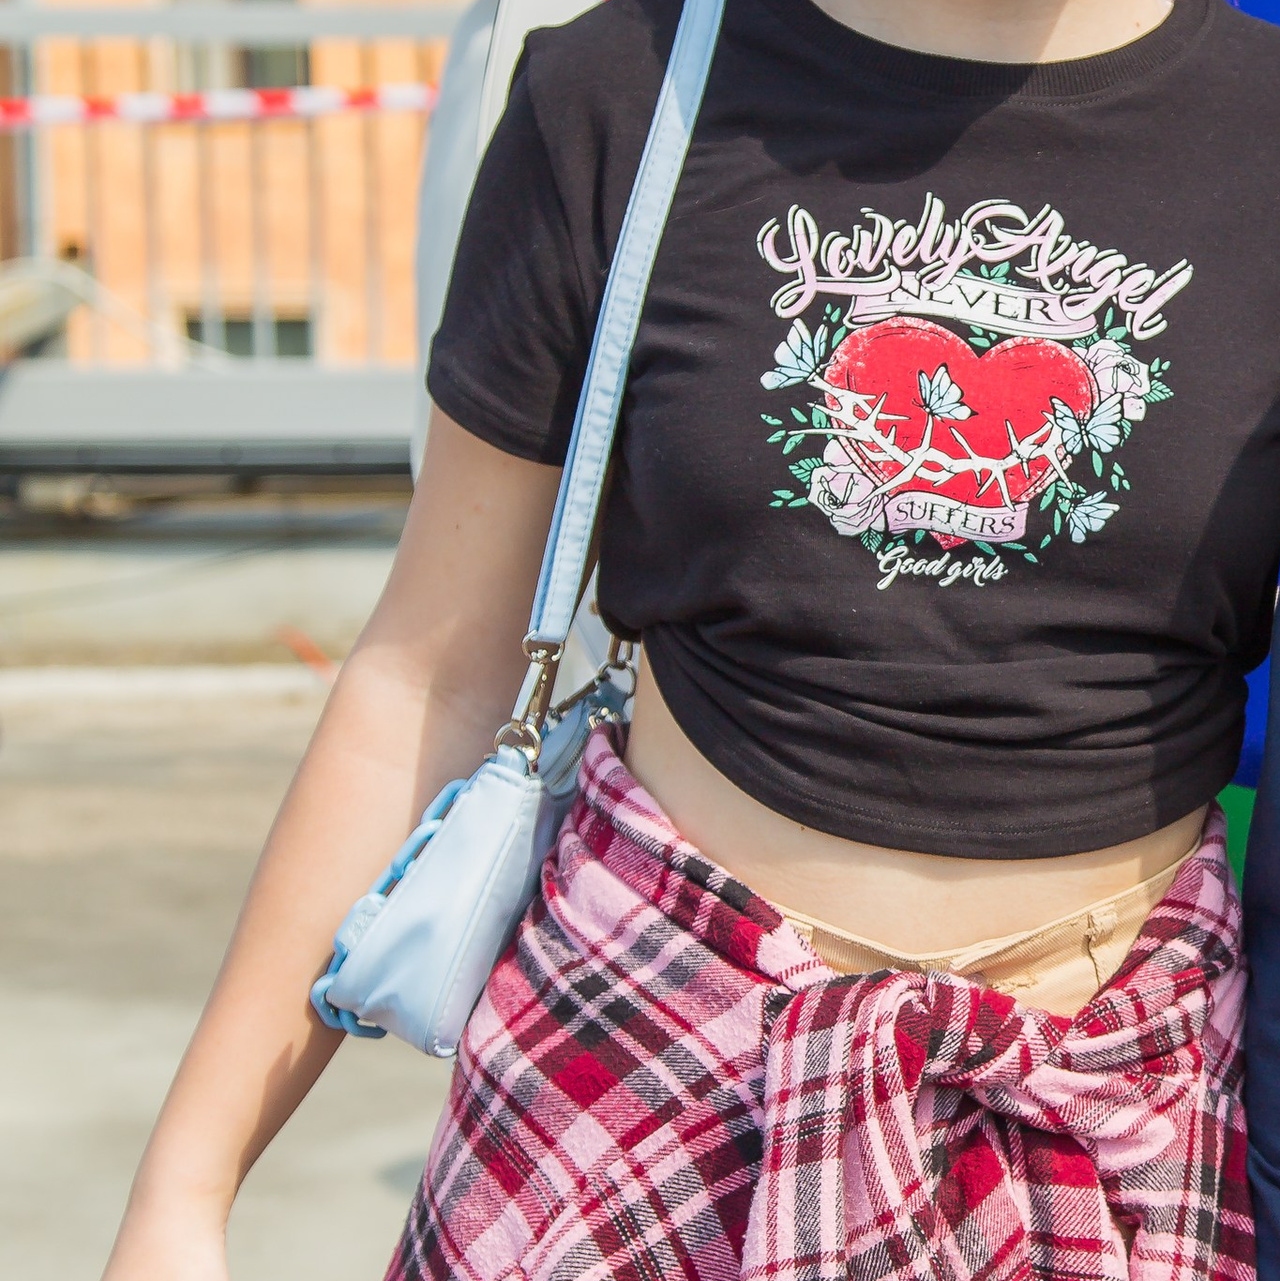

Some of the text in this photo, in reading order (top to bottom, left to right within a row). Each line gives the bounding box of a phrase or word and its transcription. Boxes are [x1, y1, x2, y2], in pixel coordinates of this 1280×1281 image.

[757, 192, 1194, 341] Lovely Angel
[895, 501, 1016, 535] SUFFERS
[876, 545, 951, 591] Good
